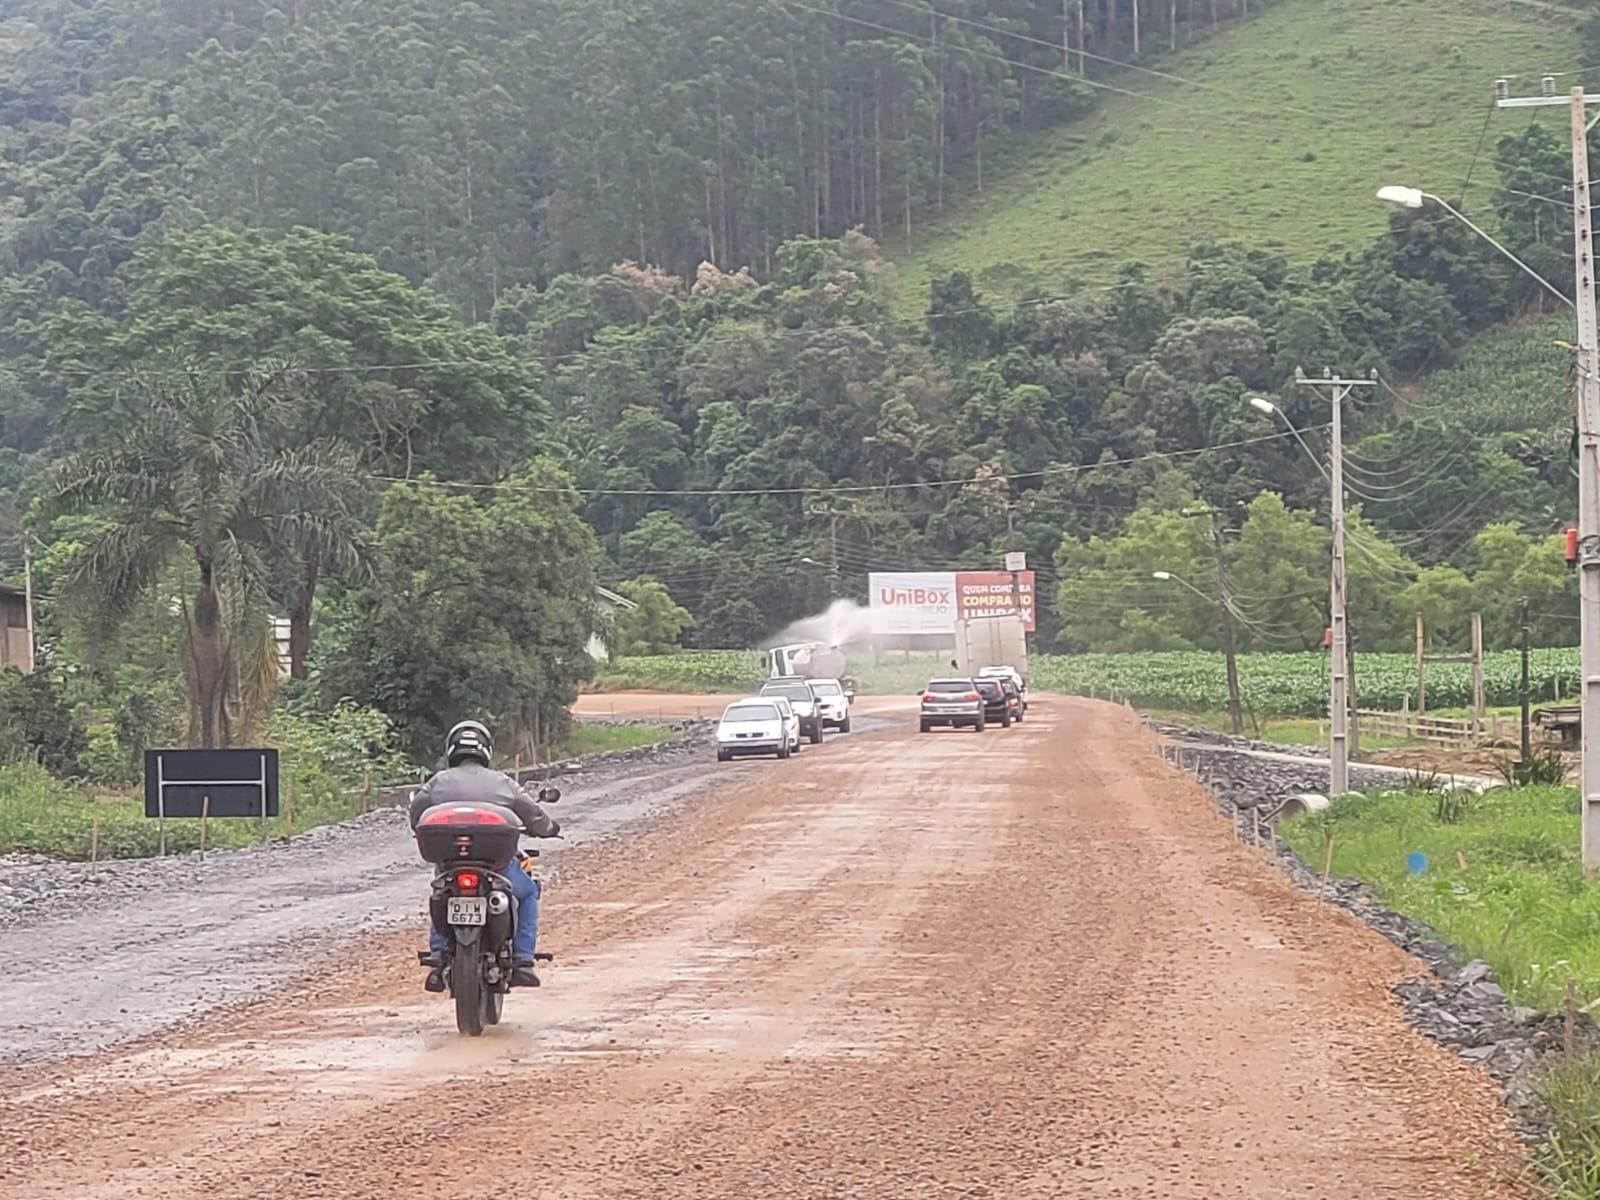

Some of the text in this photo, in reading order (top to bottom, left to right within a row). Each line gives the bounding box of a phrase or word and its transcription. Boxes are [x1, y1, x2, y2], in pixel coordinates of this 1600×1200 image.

[881, 588, 950, 605] UniBox
[963, 595, 1012, 606] COMPRA
[452, 913, 482, 923] 6673
